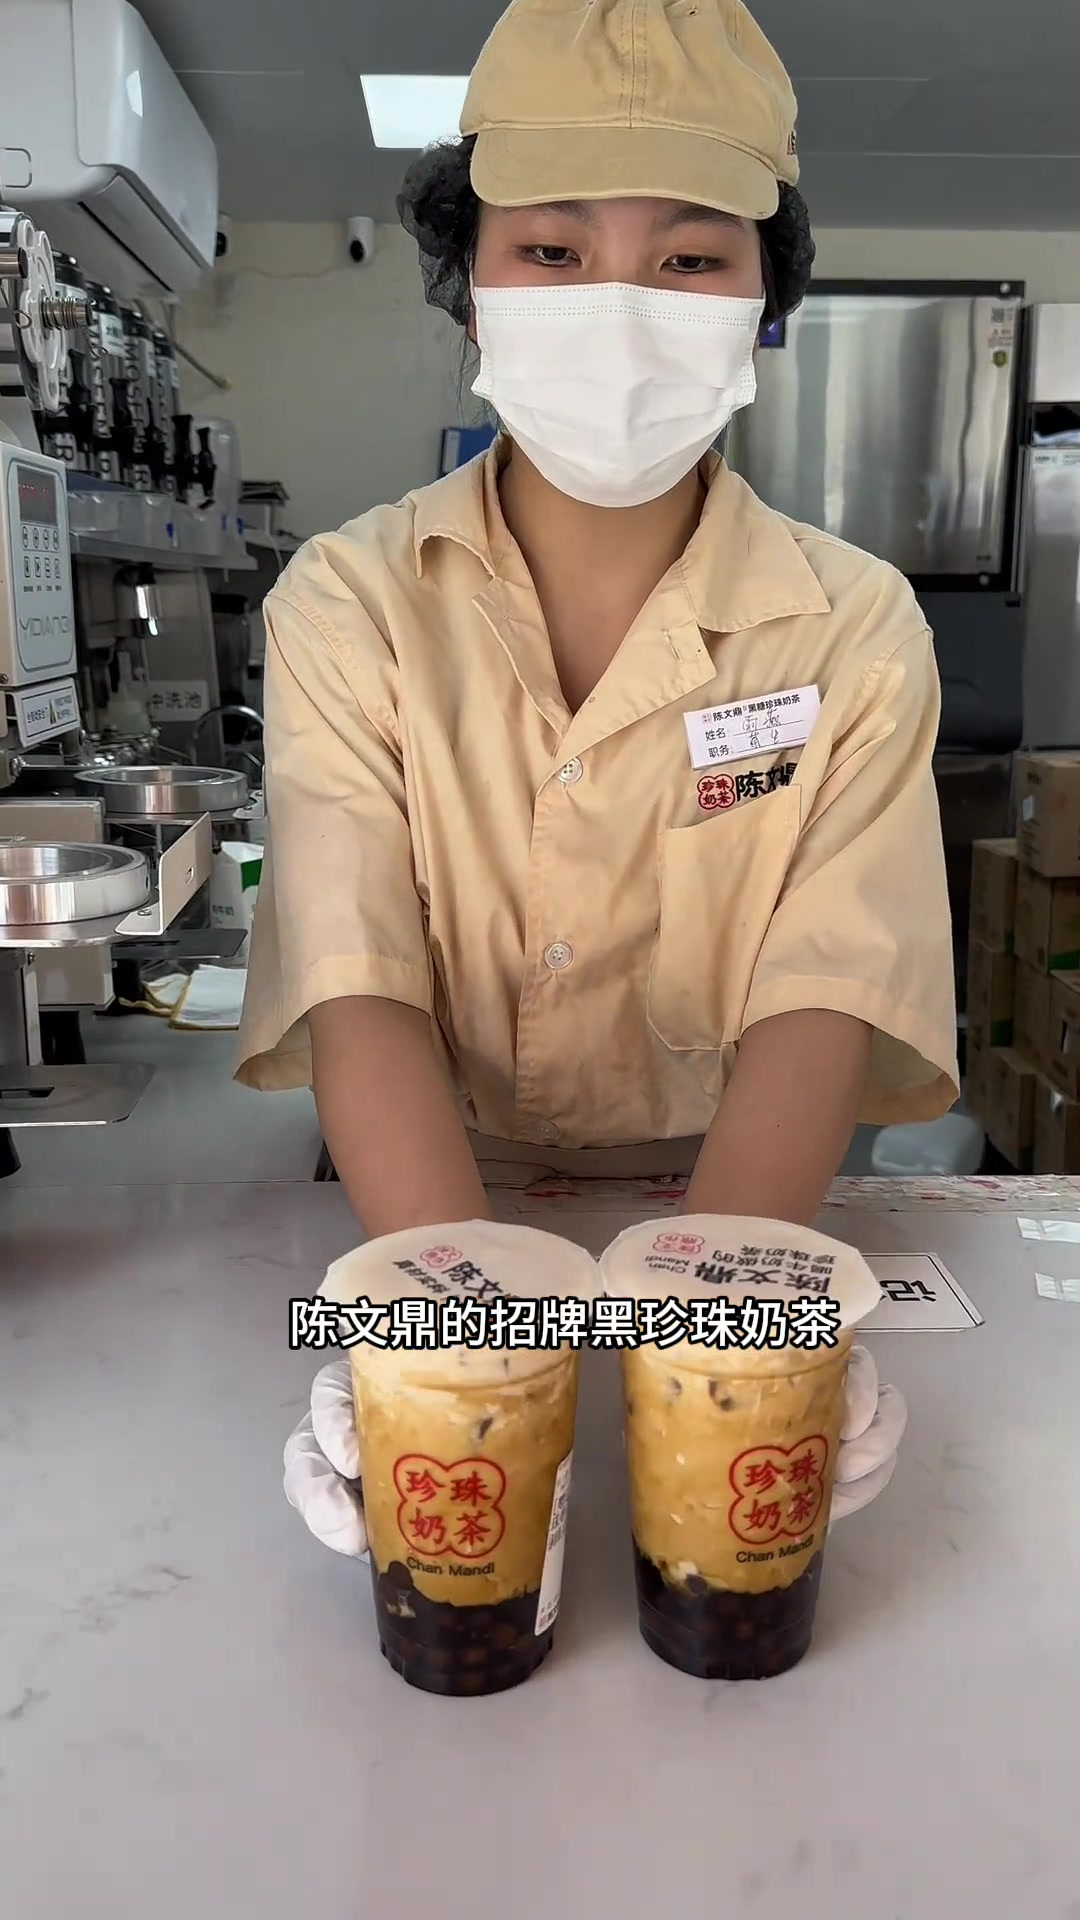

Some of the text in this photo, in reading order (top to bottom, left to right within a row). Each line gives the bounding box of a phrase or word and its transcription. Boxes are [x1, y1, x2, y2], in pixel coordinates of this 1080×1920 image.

[441, 1260, 518, 1301] 陈文
[694, 1261, 832, 1294] 陈文鼎
[880, 1279, 936, 1303] 记
[405, 1469, 494, 1507] 珍珠
[742, 1448, 819, 1495] 珍珠
[409, 1507, 492, 1546] 奶茶
[743, 1486, 816, 1531] 奶茶
[406, 1556, 443, 1576] Chan
[736, 1550, 775, 1563] Chan
